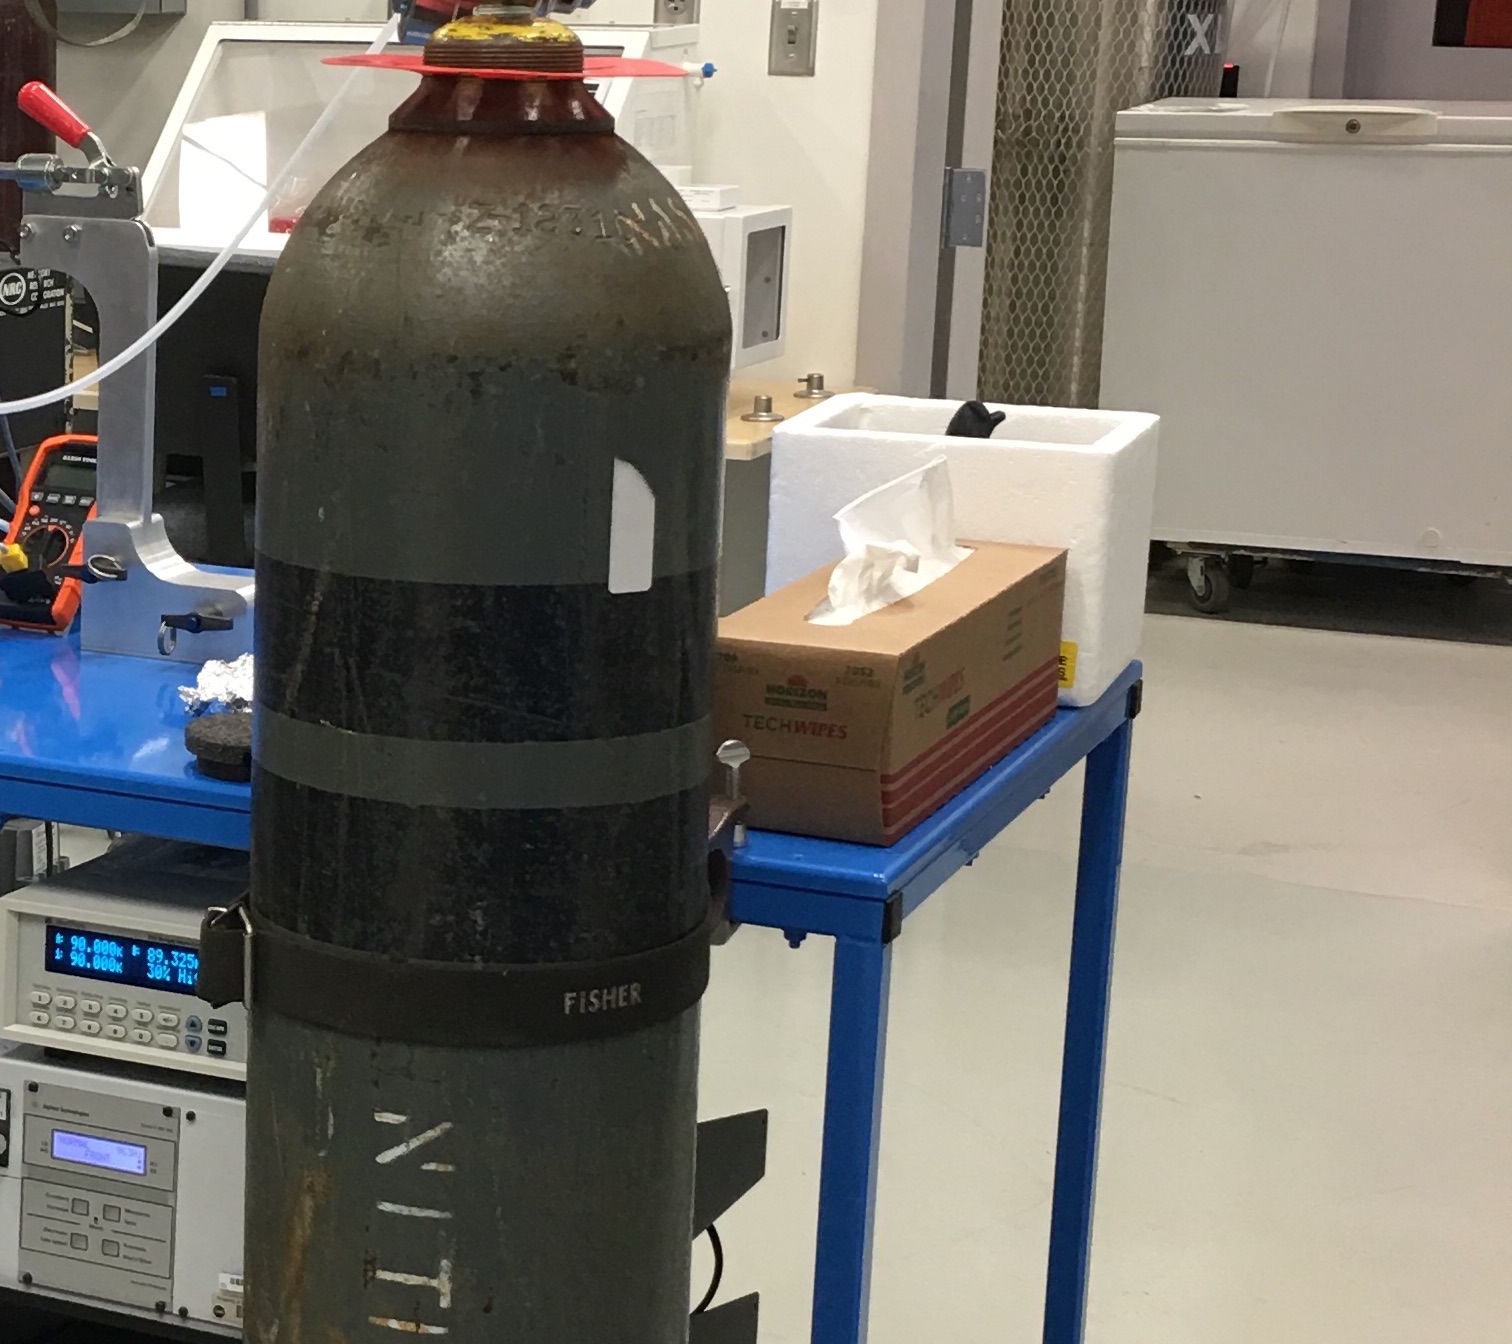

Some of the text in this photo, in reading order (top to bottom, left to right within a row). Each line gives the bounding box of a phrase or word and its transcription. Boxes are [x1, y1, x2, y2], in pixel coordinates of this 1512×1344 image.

[766, 683, 828, 700] HORIZON
[743, 713, 848, 740] TECHWIPES
[146, 962, 171, 982] 30%
[563, 982, 642, 1015] FISHER
